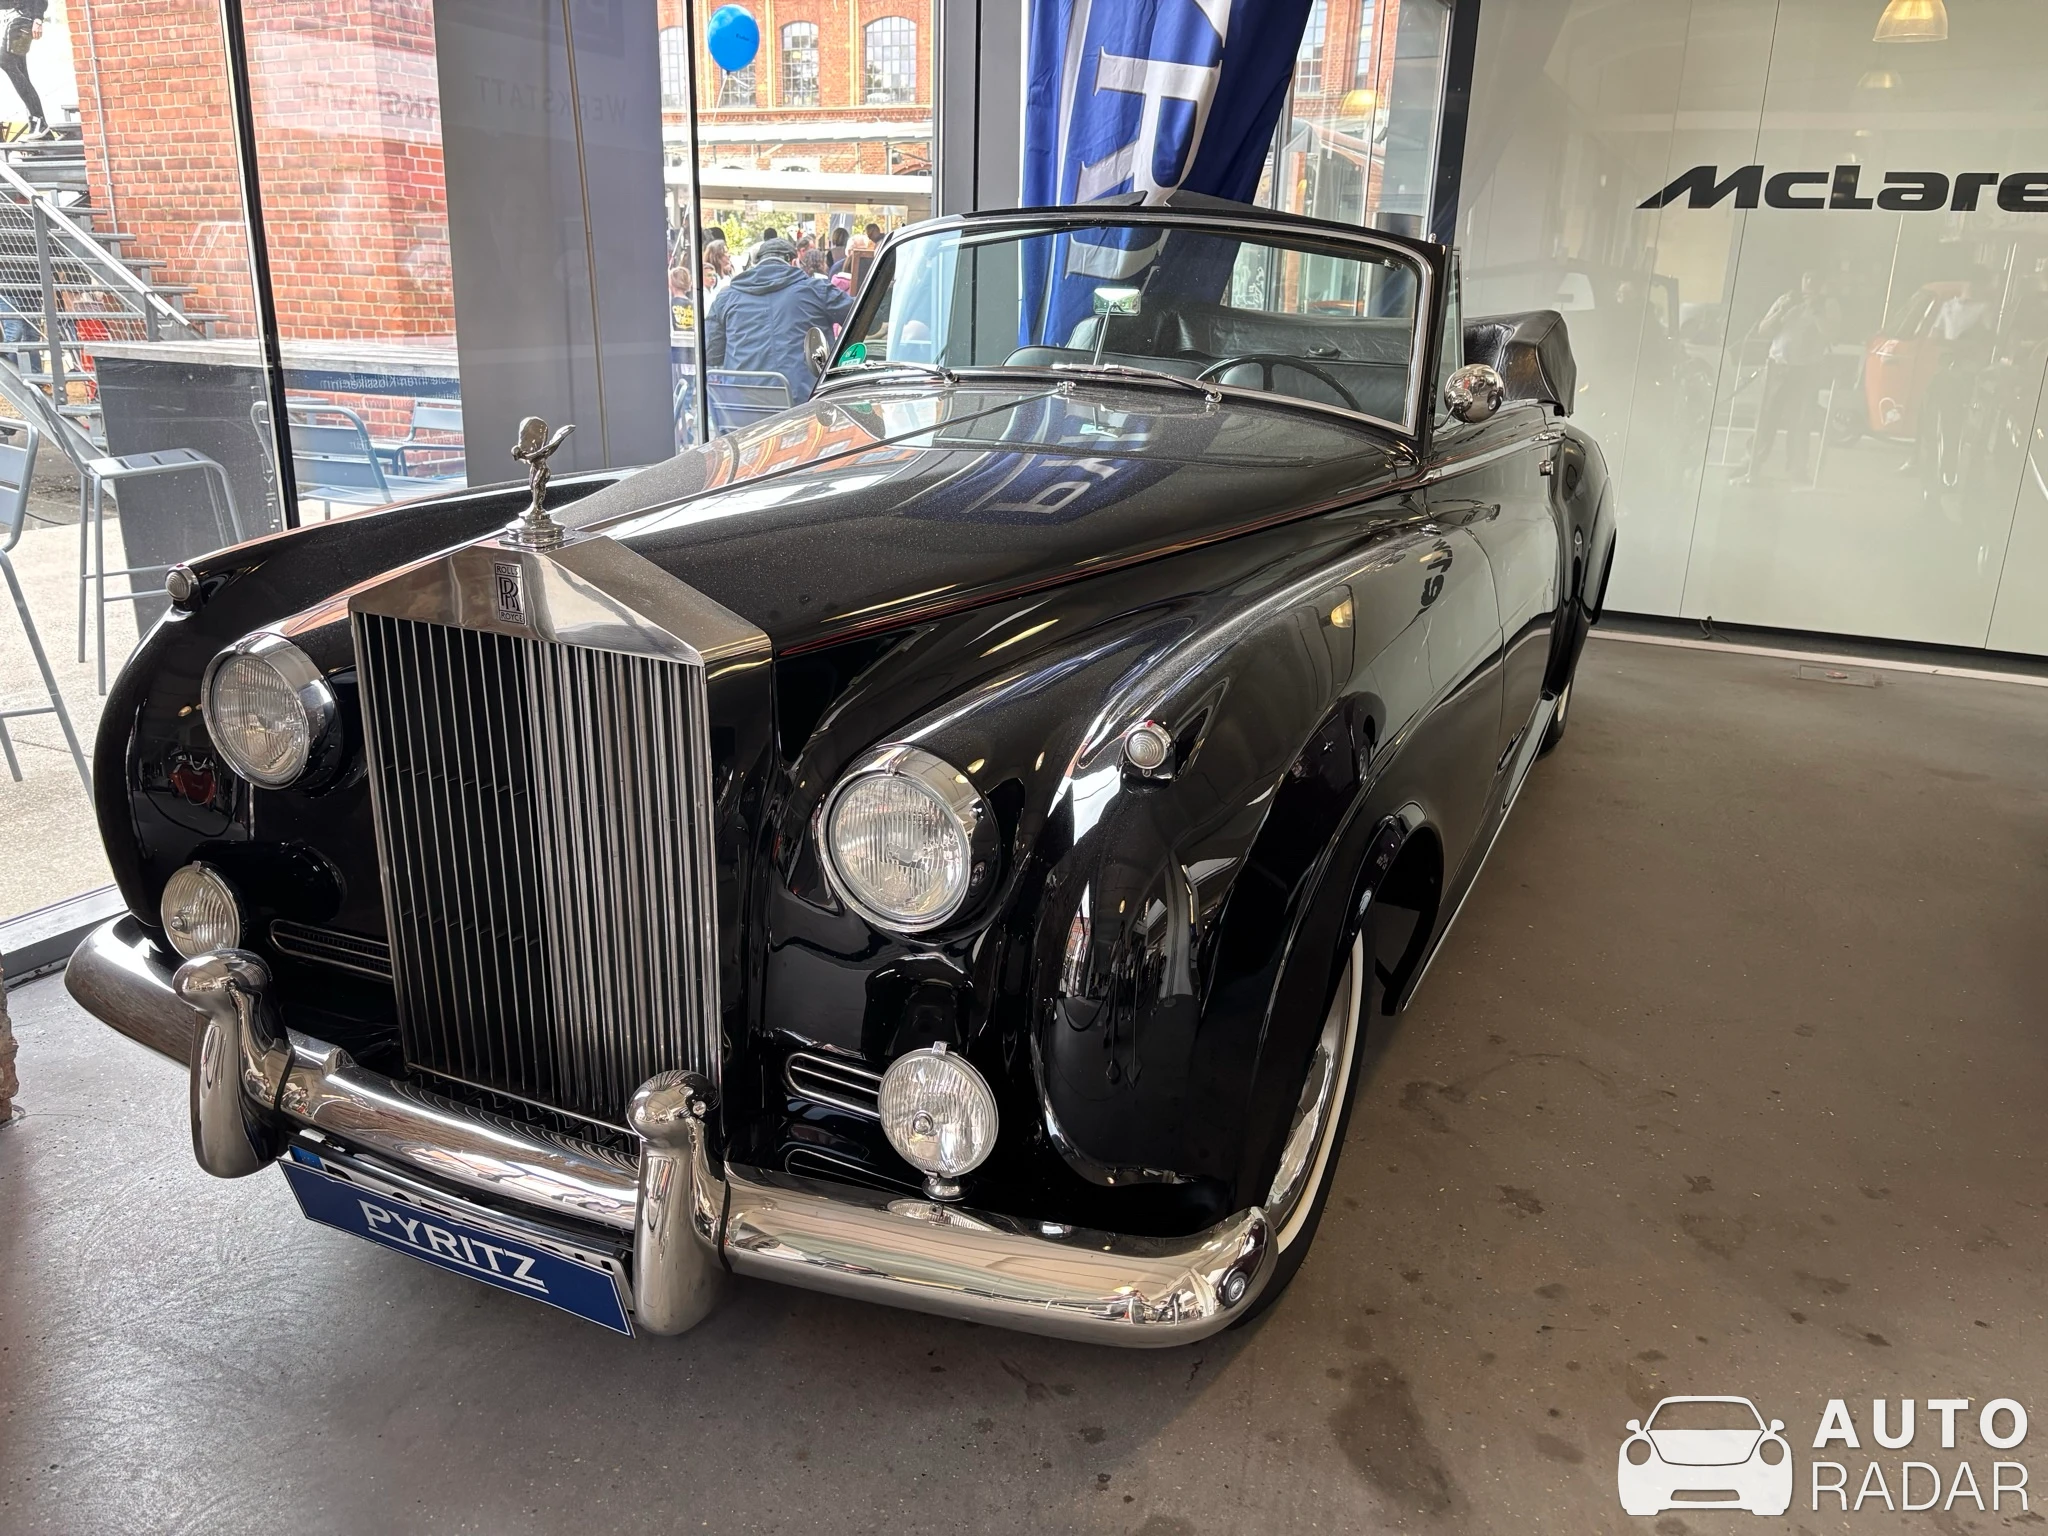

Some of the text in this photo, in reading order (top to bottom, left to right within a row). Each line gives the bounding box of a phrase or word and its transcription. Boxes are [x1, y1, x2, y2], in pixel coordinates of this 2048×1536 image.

[497, 565, 519, 576] ROLLS
[501, 612, 524, 622] ROYCE
[357, 1199, 546, 1288] PYRITZ
